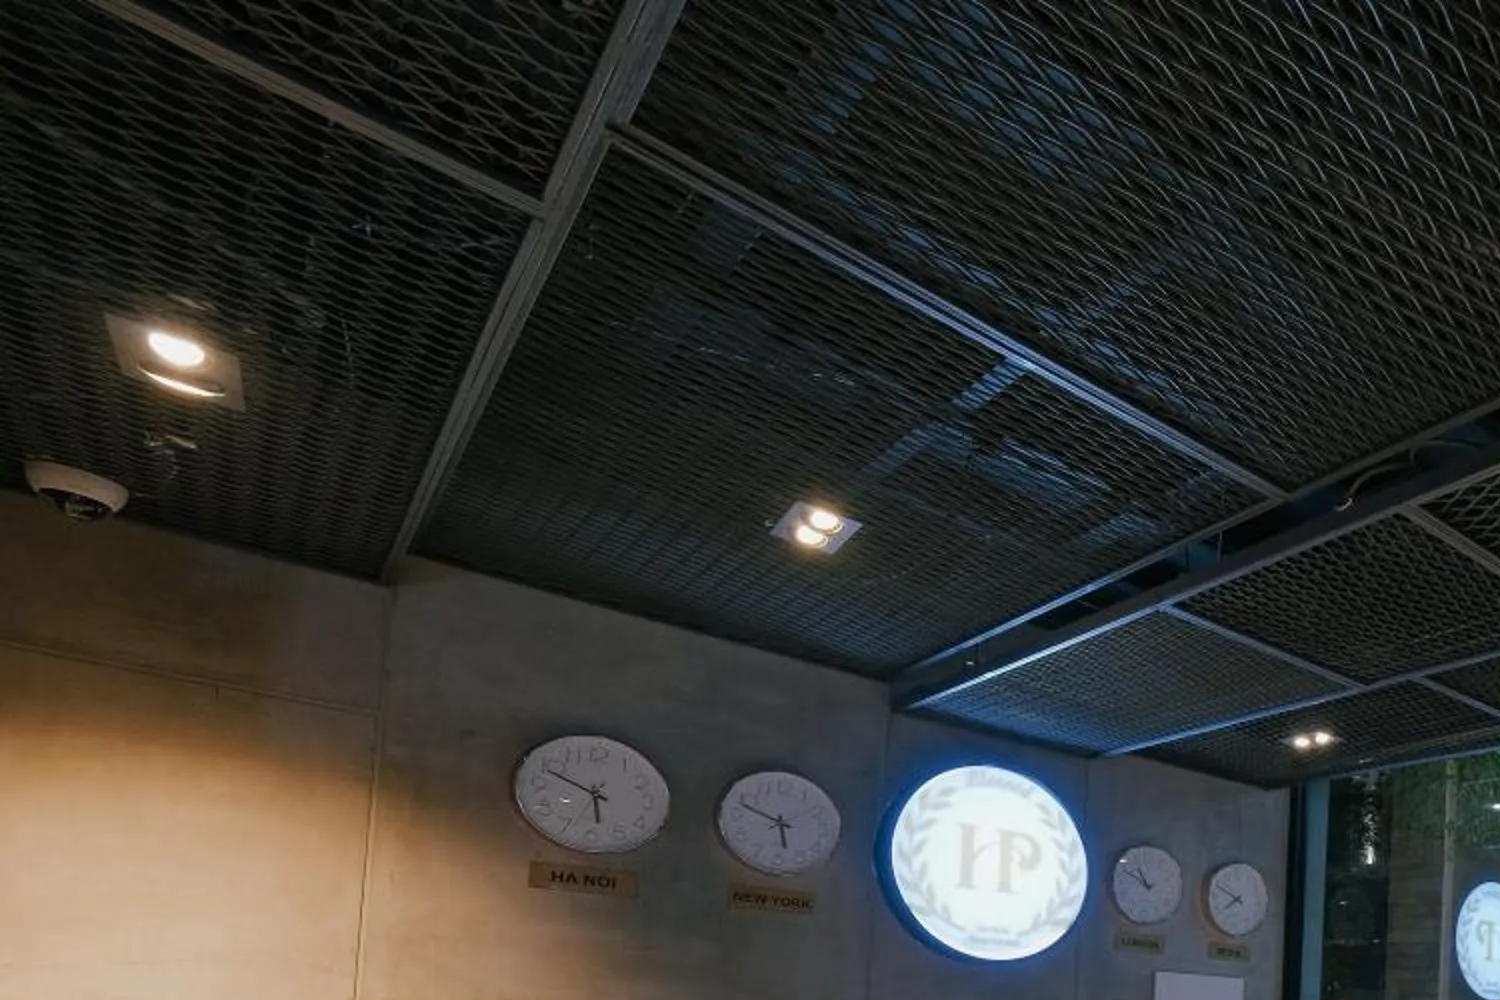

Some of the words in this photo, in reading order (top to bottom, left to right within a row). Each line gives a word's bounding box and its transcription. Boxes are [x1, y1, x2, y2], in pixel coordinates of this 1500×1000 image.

[551, 870, 578, 884] HA
[583, 875, 618, 890] NOI
[733, 891, 767, 904] NEW
[772, 896, 814, 909] YORK
